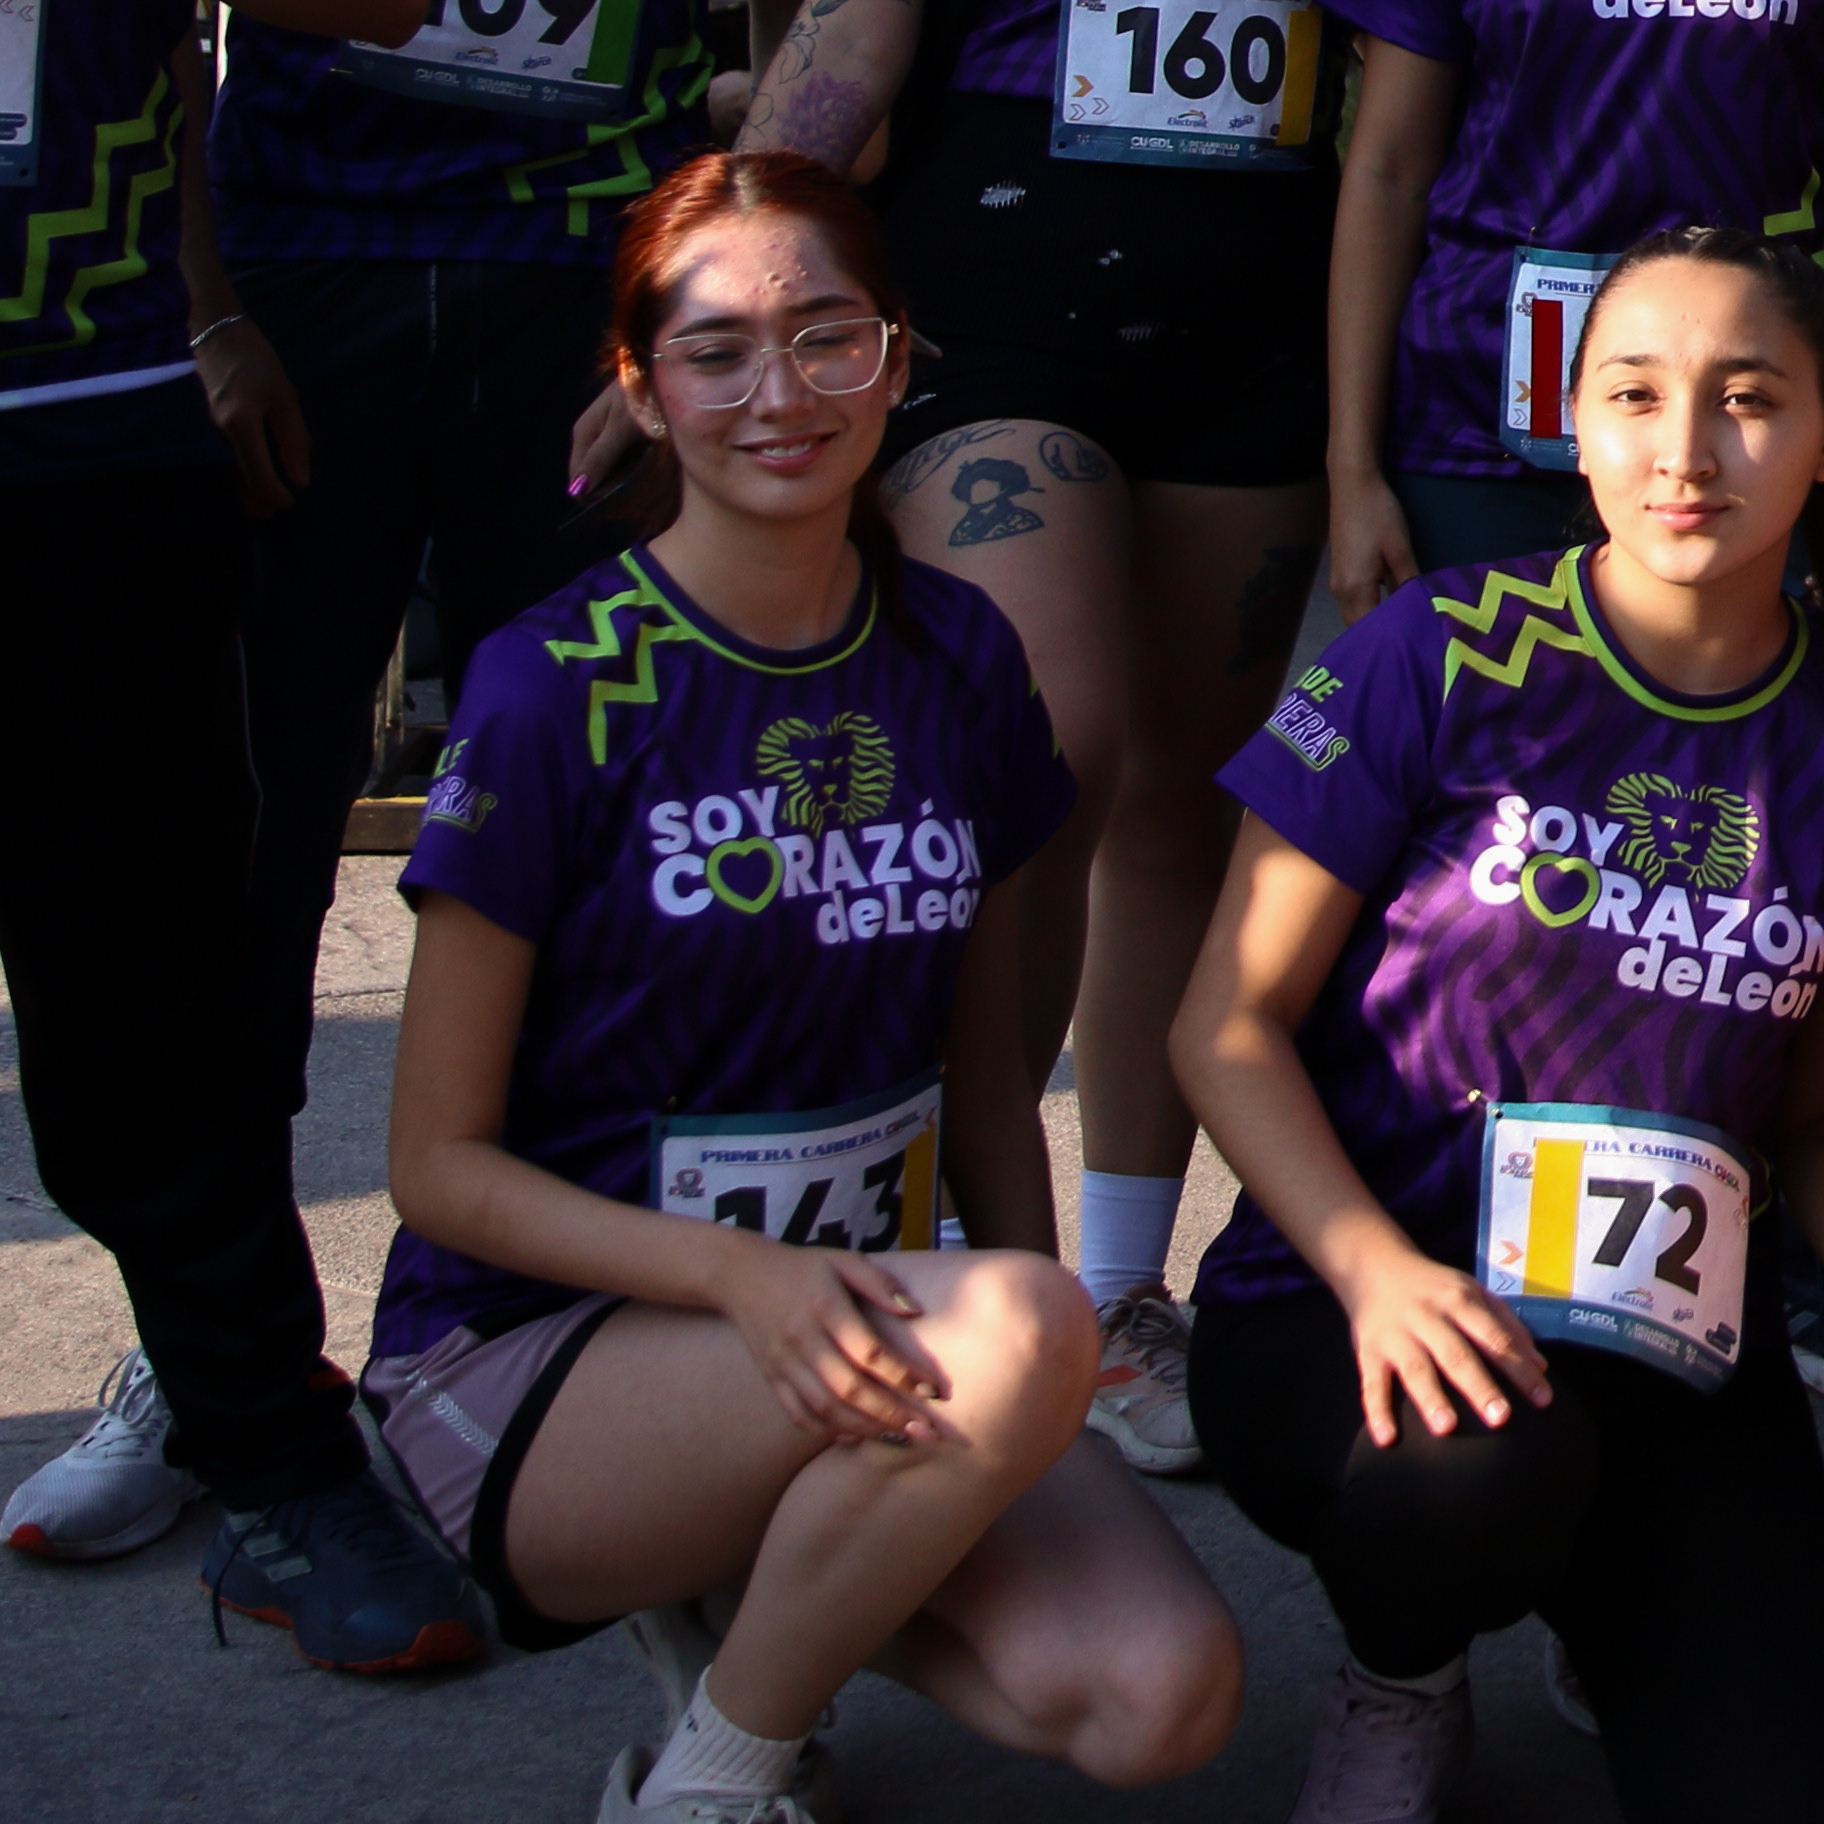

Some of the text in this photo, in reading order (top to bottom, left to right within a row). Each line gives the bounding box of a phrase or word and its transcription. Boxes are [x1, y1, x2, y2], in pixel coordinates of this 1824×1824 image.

[1116, 6, 1287, 106] 160
[1130, 135, 1174, 149] CUGDL
[1301, 666, 1345, 703] DE
[649, 786, 779, 855] SOY
[1492, 795, 1625, 859] SOY
[701, 1147, 794, 1164] PRIMERA
[801, 1127, 881, 1159] CARRERA
[1628, 1142, 1712, 1171] CARRERA
[714, 1147, 907, 1254] 143
[1587, 1176, 1708, 1297] 72
[1568, 1307, 1619, 1329] CUGDL
